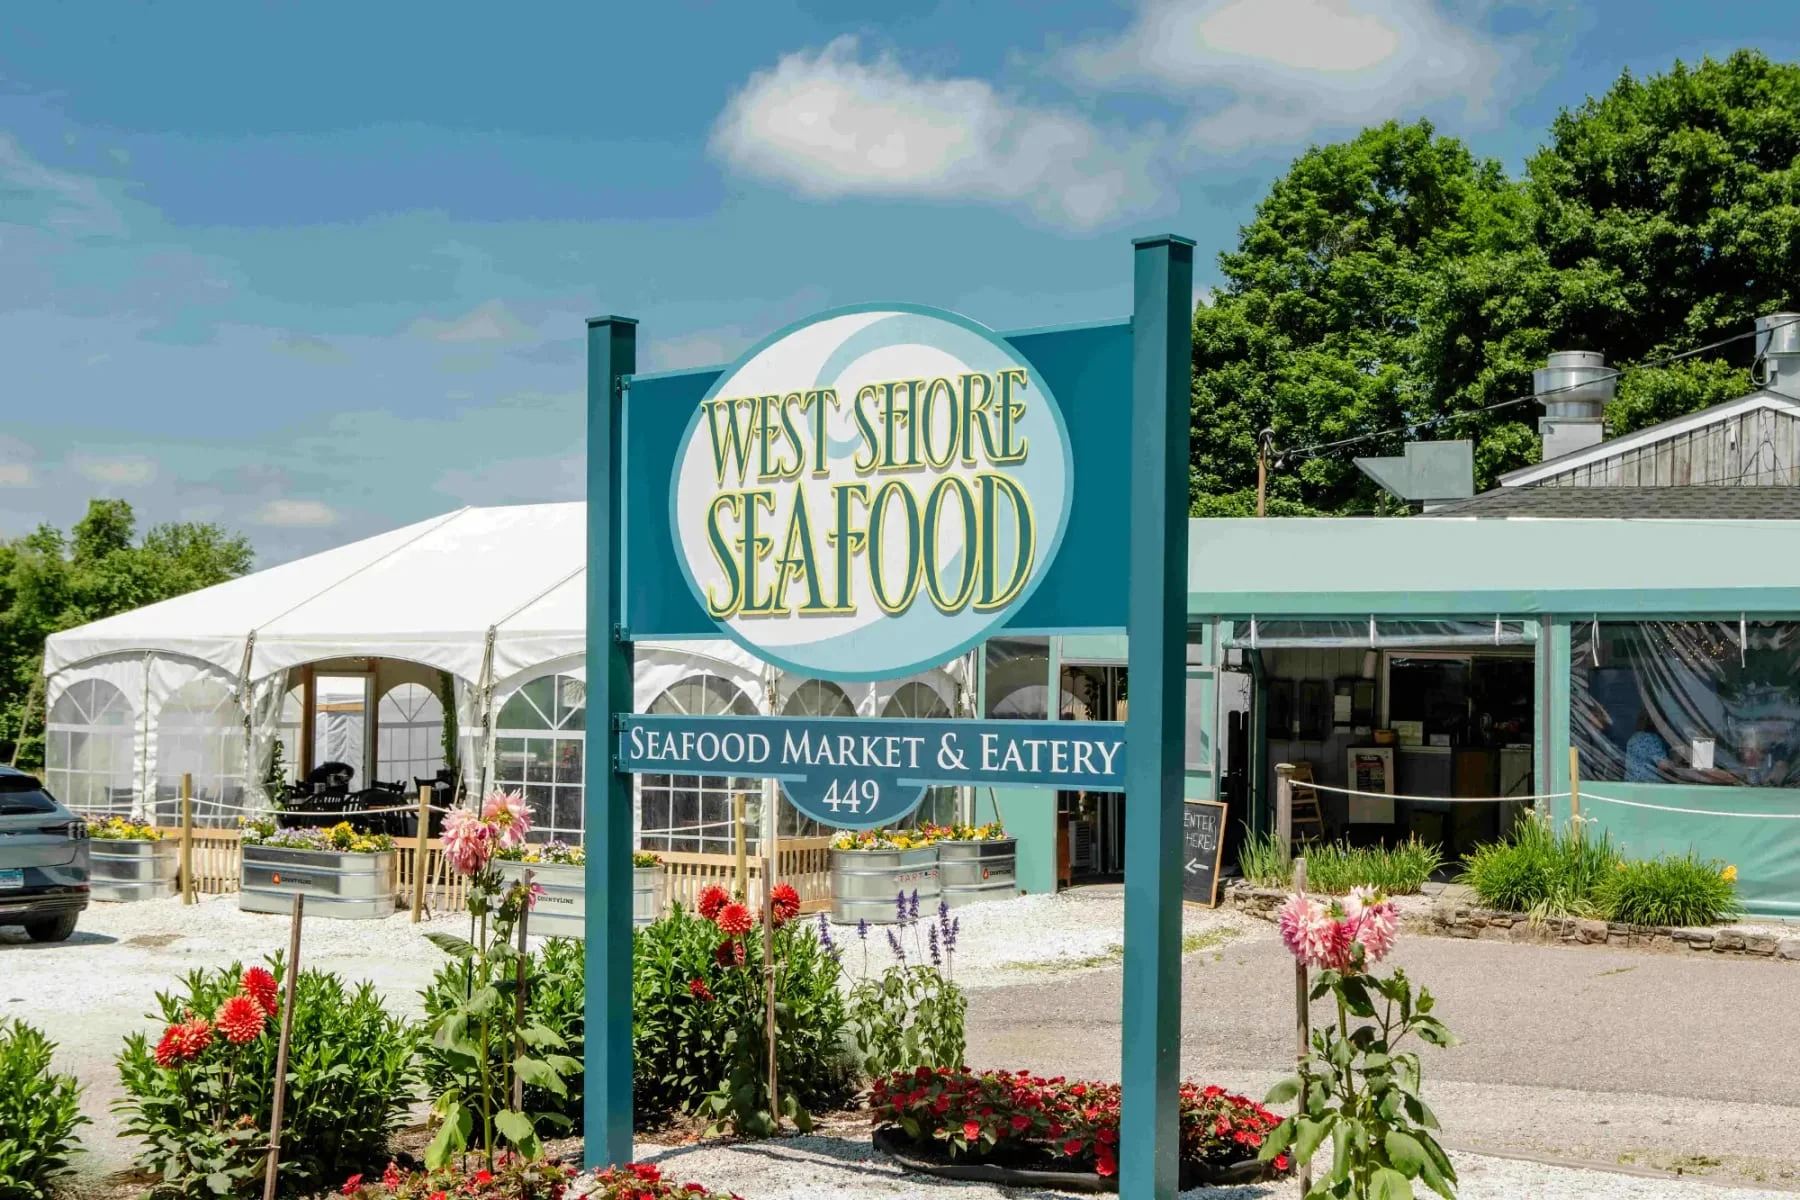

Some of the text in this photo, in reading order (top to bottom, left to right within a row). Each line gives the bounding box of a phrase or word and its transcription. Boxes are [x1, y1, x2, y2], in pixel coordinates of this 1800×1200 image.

[701, 368, 1028, 484] WEST SHORE
[706, 471, 1036, 617] SEAFOOD
[630, 726, 1123, 775] SEAFOOD MARKET & EATERY
[822, 778, 880, 814] 449
